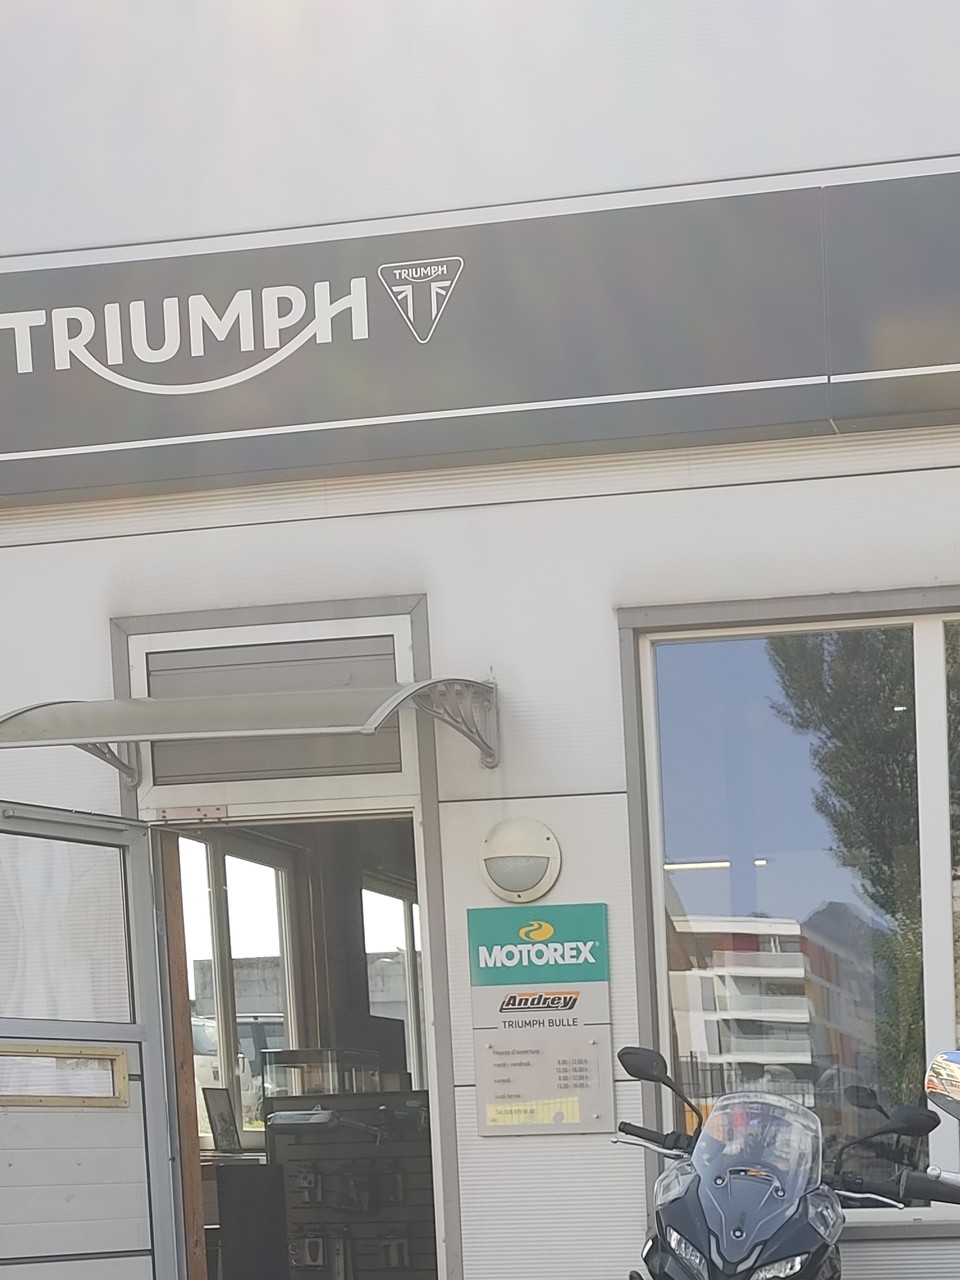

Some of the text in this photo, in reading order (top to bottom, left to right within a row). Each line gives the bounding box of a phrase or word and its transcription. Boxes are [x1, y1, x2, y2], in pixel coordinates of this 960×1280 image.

[392, 264, 447, 282] TRIUMPH
[0, 277, 369, 395] TRIUMPH
[478, 941, 596, 968] MOTOREX
[504, 994, 574, 1010] Andrey
[502, 1018, 578, 1029] TRIUMPH BULLE
